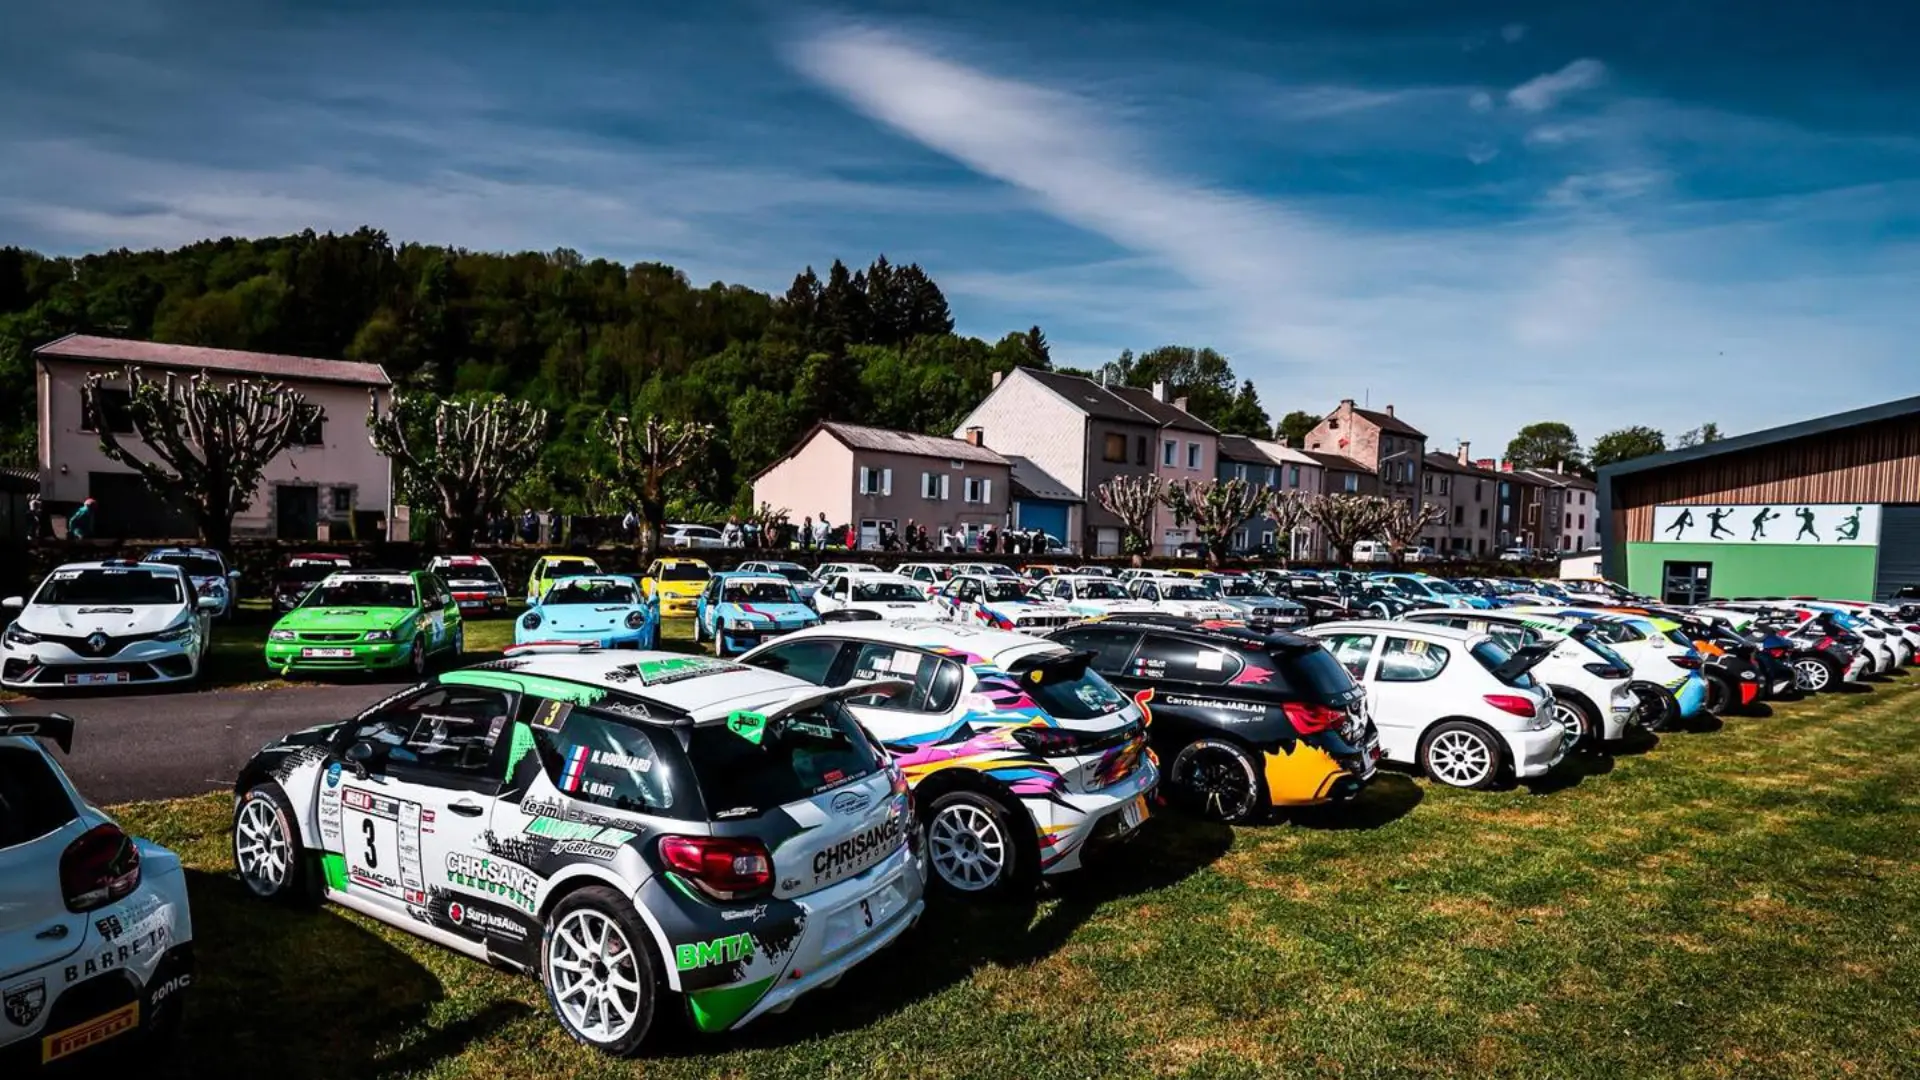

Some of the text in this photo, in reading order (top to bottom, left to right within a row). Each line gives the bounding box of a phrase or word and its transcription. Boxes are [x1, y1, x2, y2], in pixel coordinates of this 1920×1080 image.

[544, 702, 561, 726] 3
[1166, 695, 1266, 713] Carrosserie JARLAN
[589, 782, 615, 798] OLIVET
[522, 799, 559, 818] team
[362, 818, 378, 869] 3
[812, 815, 900, 874] CHRISANGE
[859, 898, 873, 927] 3
[64, 941, 142, 982] BARRE
[676, 932, 755, 971] BMTA
[50, 1007, 134, 1058] PIRELLI
